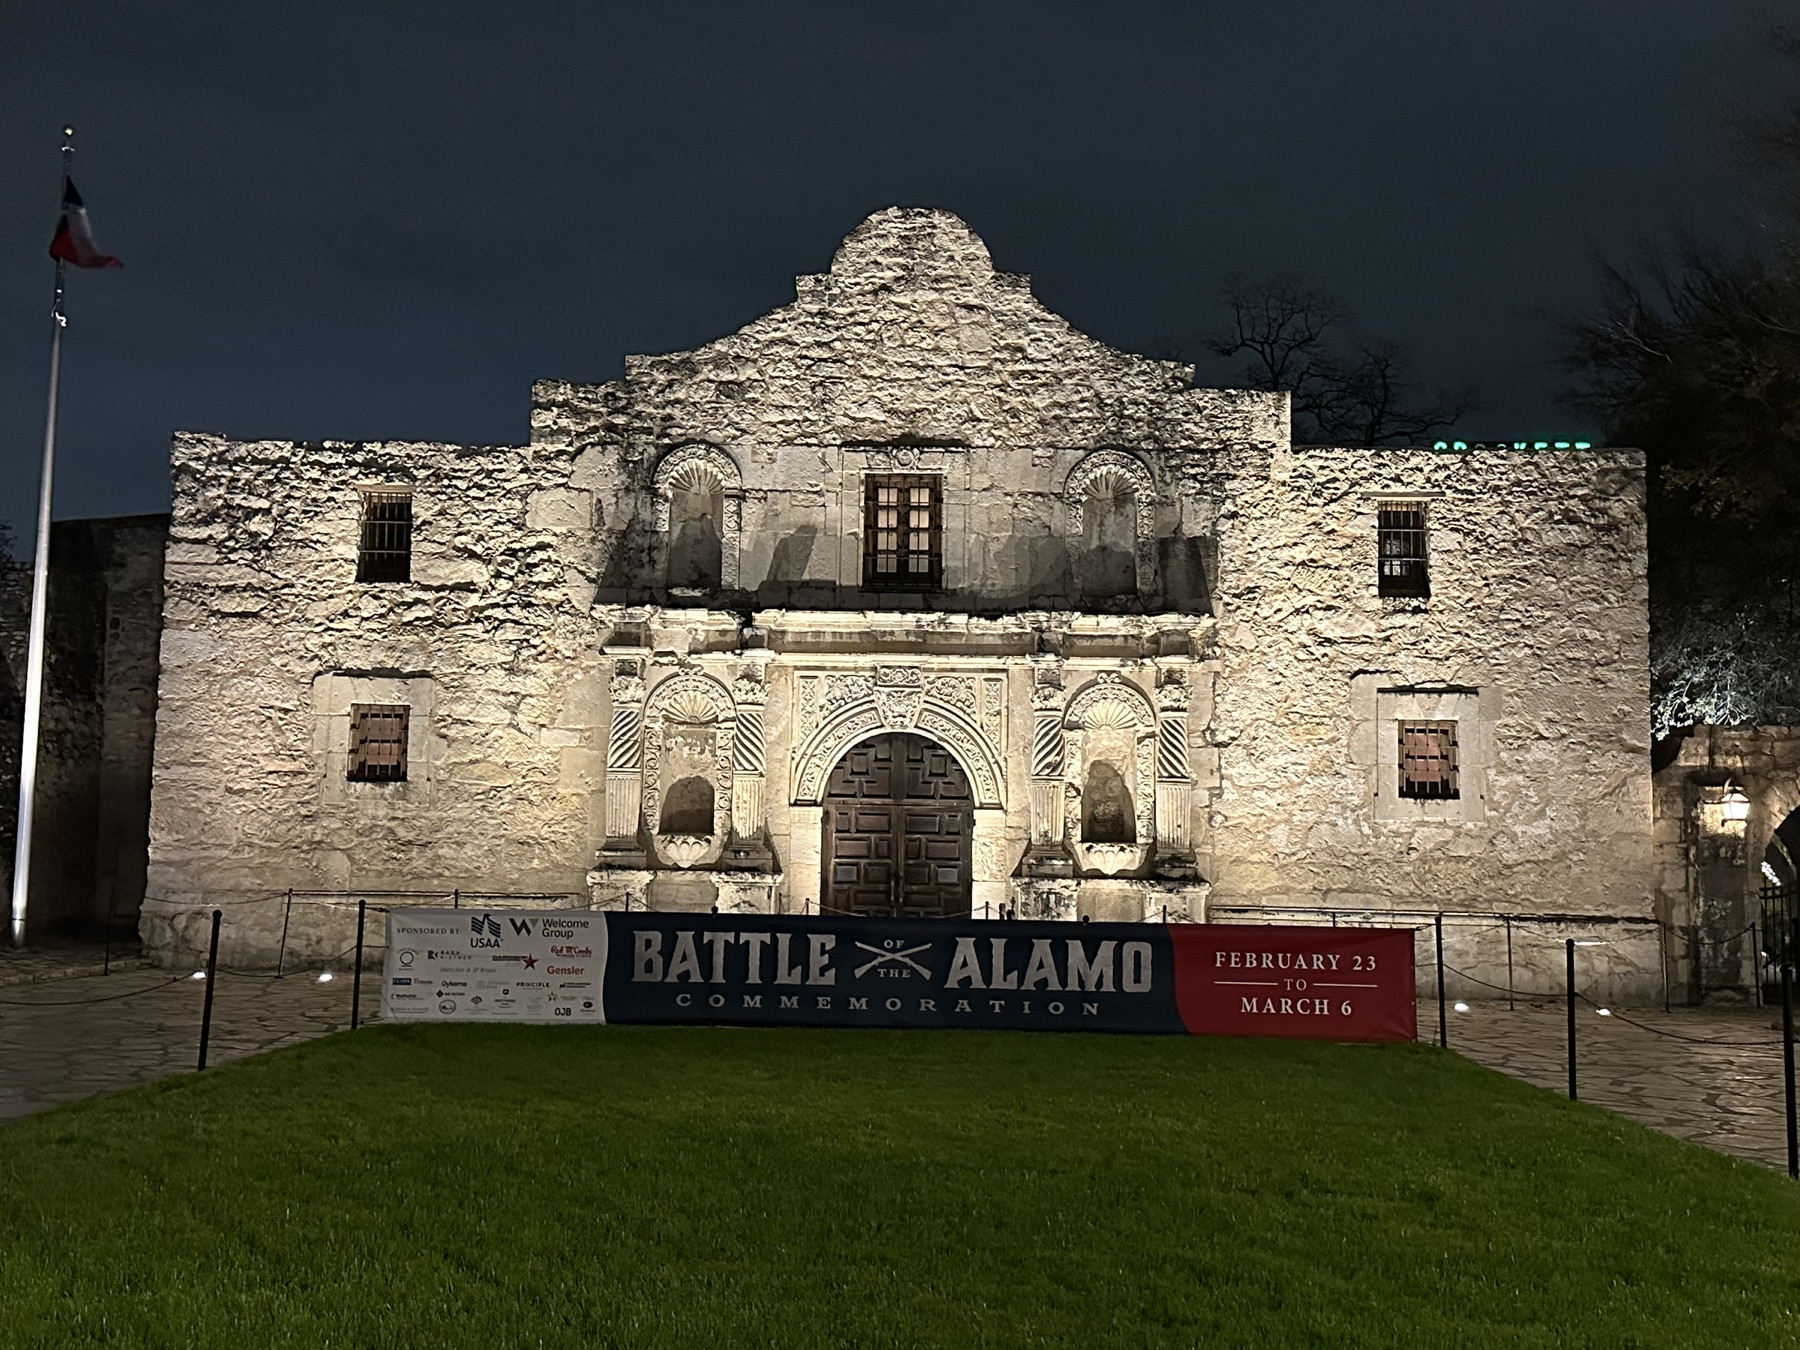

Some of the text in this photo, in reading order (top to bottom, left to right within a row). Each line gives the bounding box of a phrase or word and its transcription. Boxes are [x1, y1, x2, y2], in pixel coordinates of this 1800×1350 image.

[542, 918, 590, 929] Welcome
[396, 927, 447, 935] SPONSORED
[541, 928, 574, 940] Group
[470, 938, 500, 949] USAA
[631, 930, 1152, 993] BATTLE OF THE ALAMO
[1215, 951, 1377, 971] FEBRUARY 23
[546, 965, 585, 976] Gensler
[1284, 978, 1307, 991] TO
[675, 994, 1099, 1016] COMMEMORATION
[1240, 997, 1352, 1016] MARCH 6
[555, 1007, 572, 1017] OJB
